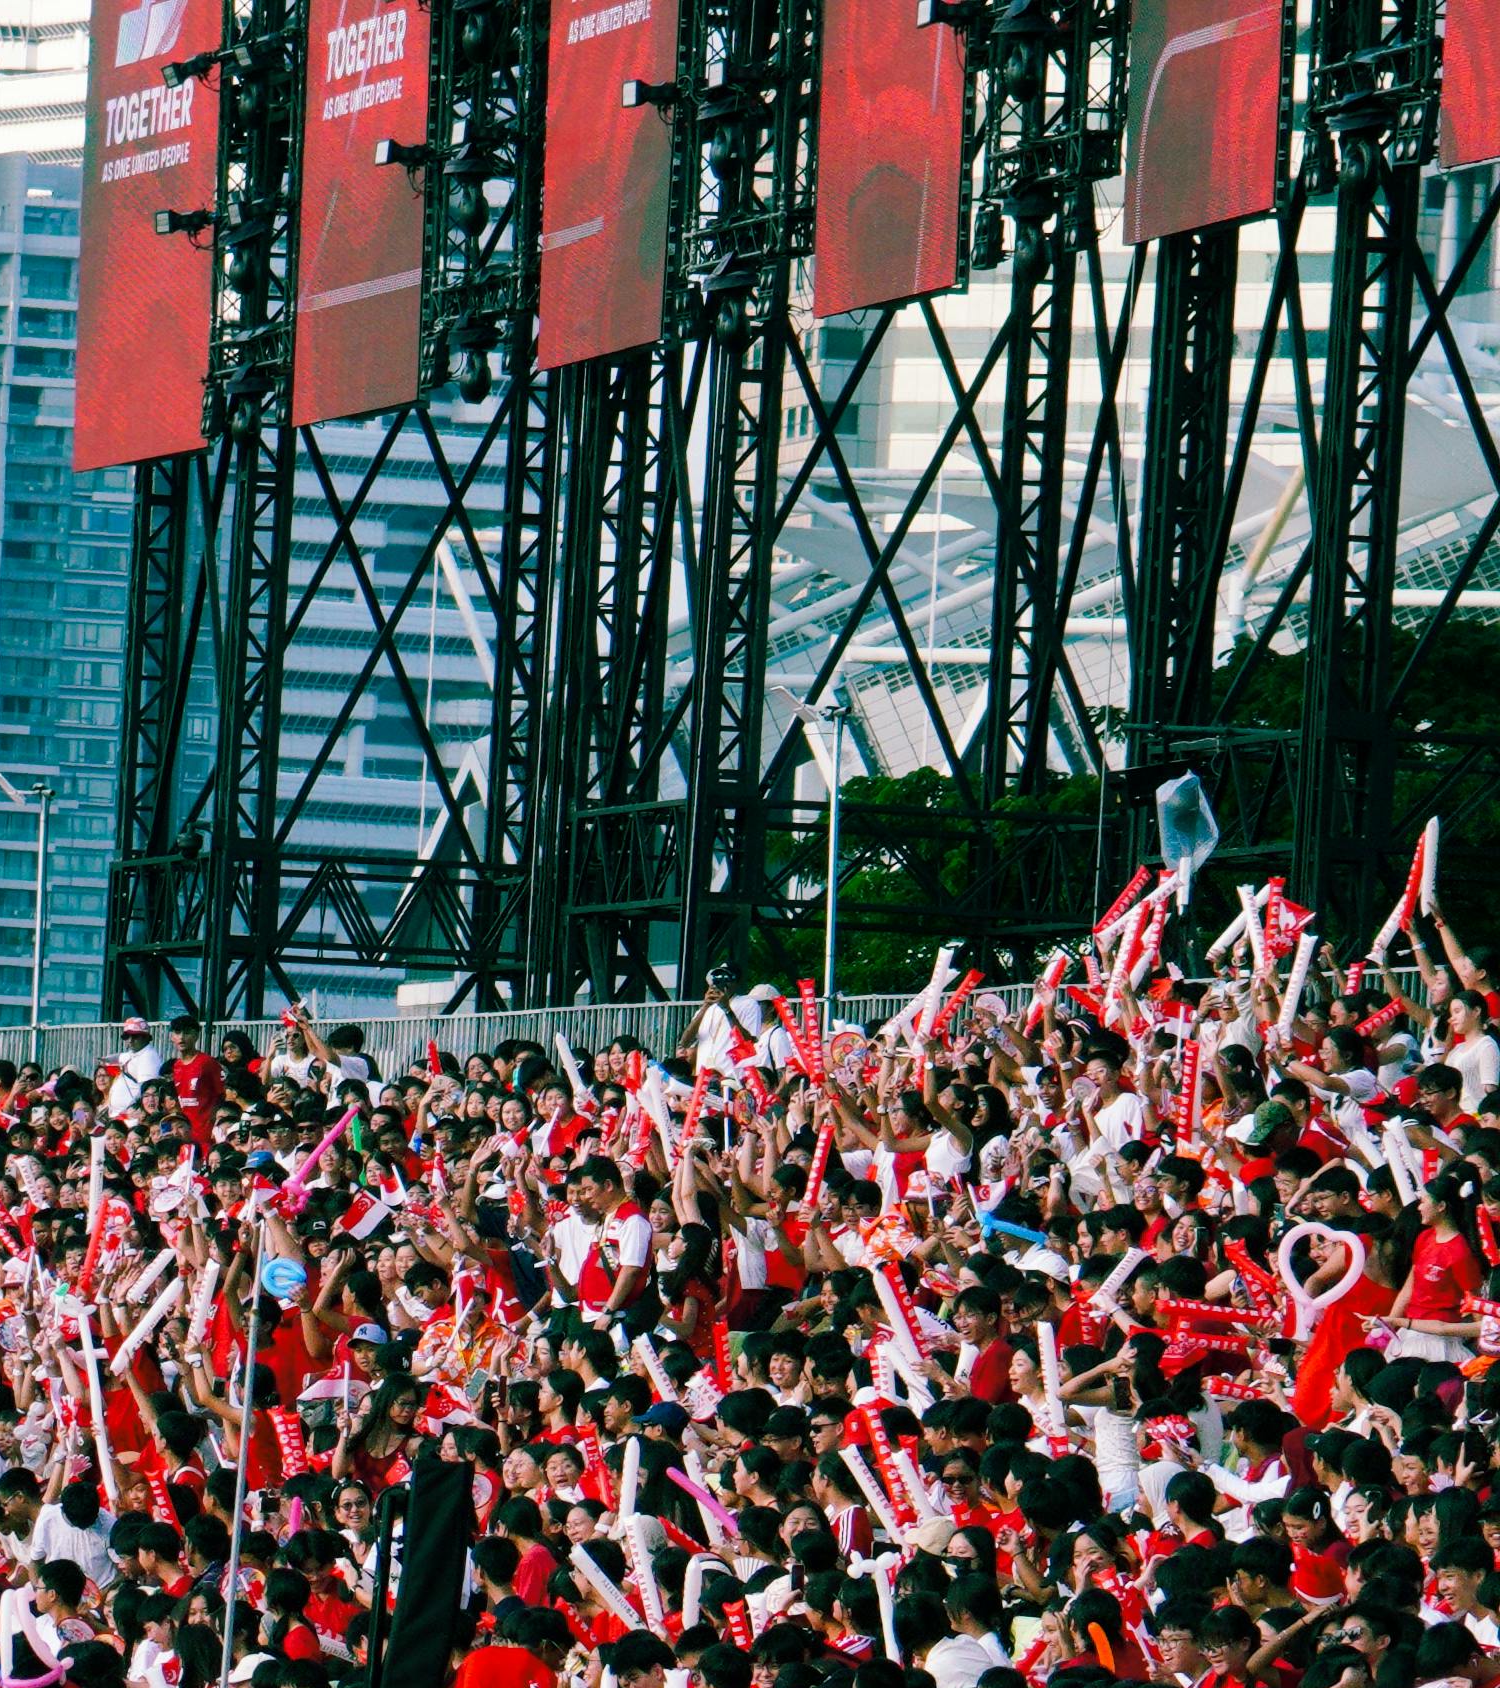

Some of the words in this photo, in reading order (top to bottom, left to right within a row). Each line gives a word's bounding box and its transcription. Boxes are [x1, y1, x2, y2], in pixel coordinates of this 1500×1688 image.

[325, 9, 407, 82] TOGETHER
[567, 23, 579, 45] AS
[596, 9, 622, 37] UNITED
[623, 0, 652, 29] PEOPLE
[104, 80, 193, 147] TOGETHER
[322, 98, 333, 121] AS
[334, 94, 349, 118] ONE
[350, 86, 374, 113] UNITED
[375, 75, 402, 108] PEOPLE
[101, 161, 113, 183] AS
[114, 156, 130, 179] ONE
[131, 149, 158, 177] UNITED
[159, 140, 190, 170] PEOPLE
[866, 1407, 907, 1512] SINGAPORE
[625, 1522, 644, 1572] HAPPY
